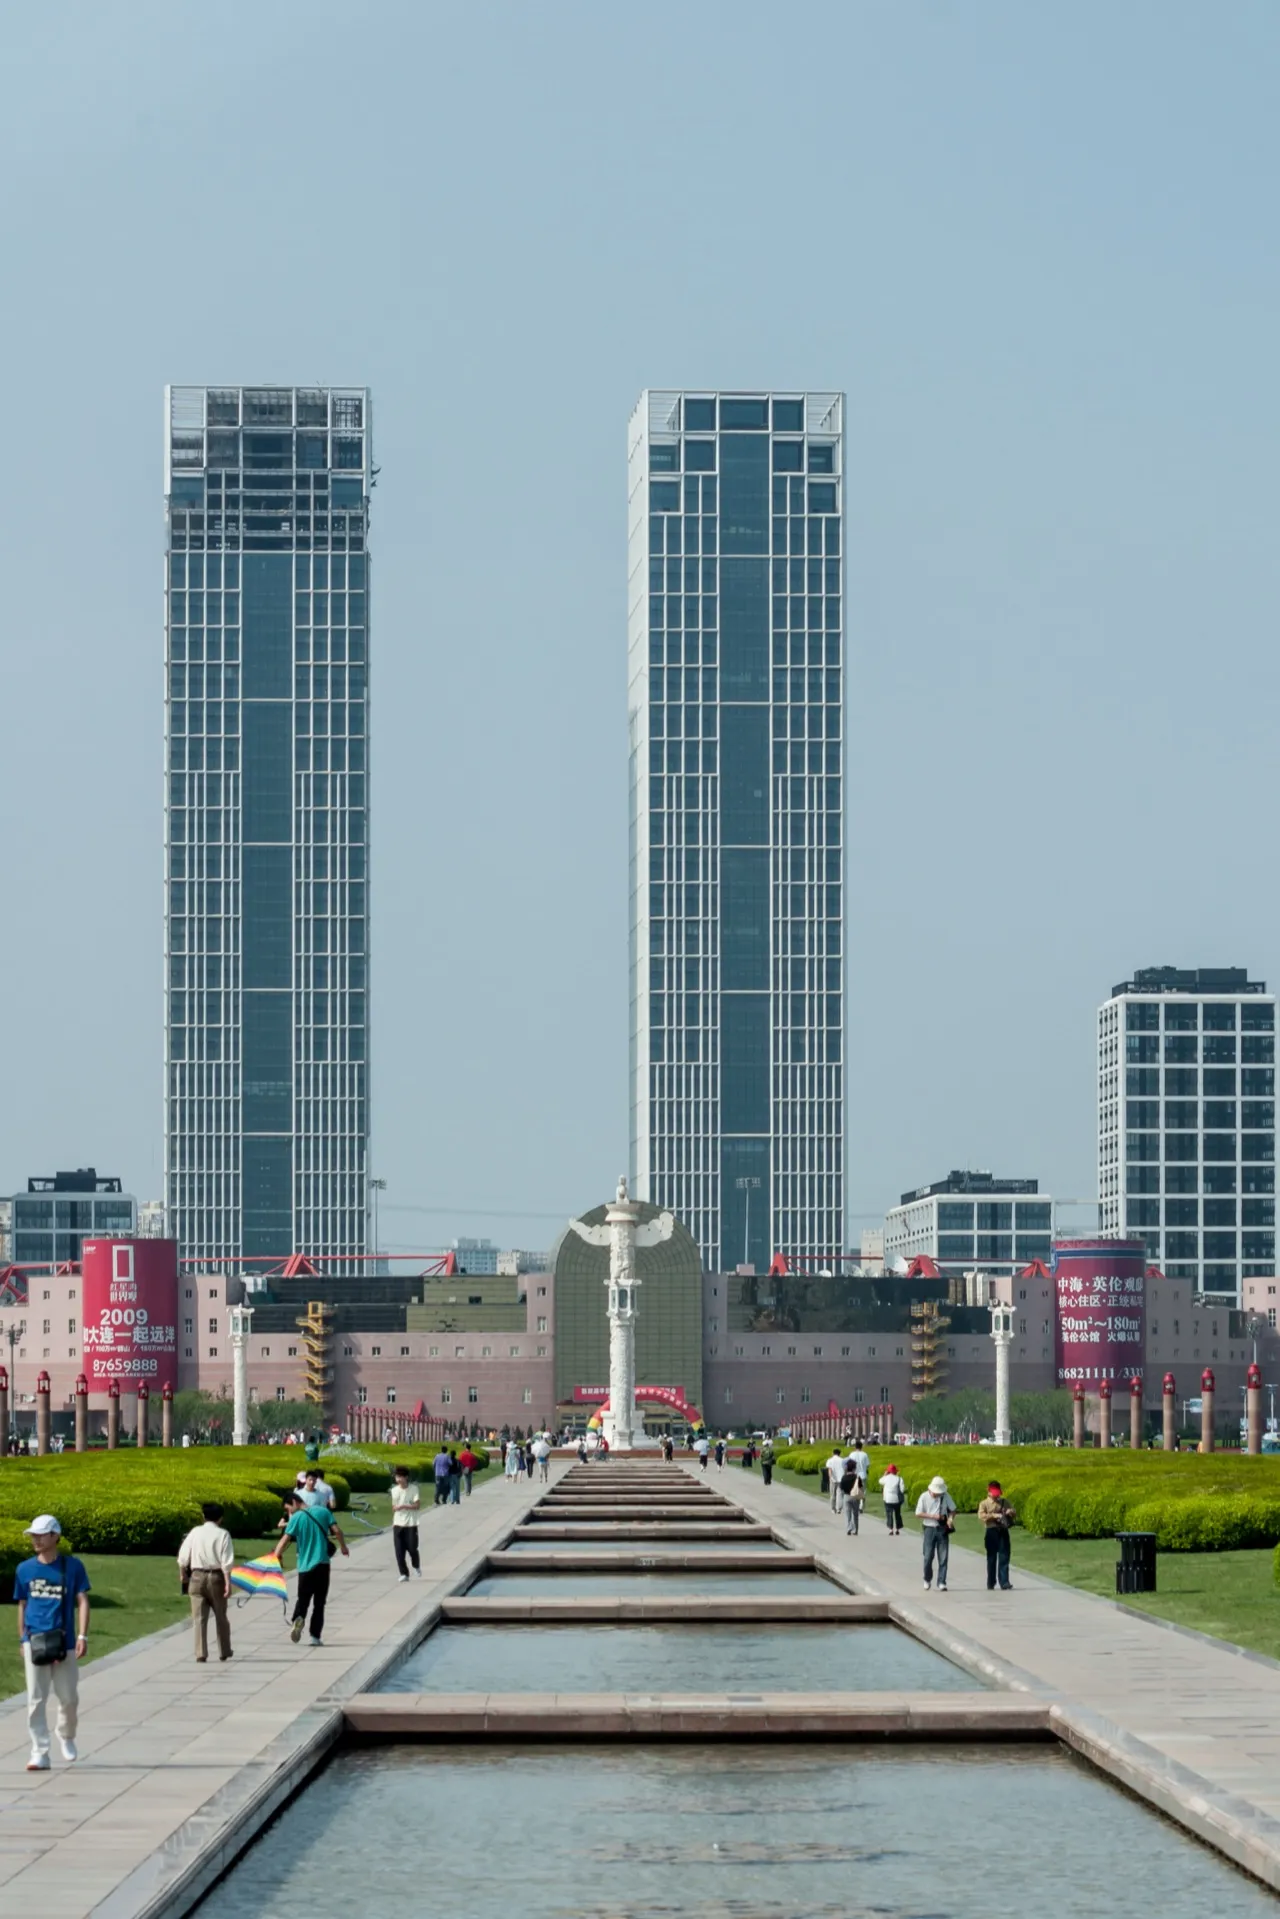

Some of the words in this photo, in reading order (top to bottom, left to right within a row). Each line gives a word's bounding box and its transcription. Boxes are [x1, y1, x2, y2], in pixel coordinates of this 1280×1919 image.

[100, 1308, 148, 1325] 2009
[1061, 1331, 1100, 1343] 英伦公馆
[93, 1359, 158, 1373] 87659888
